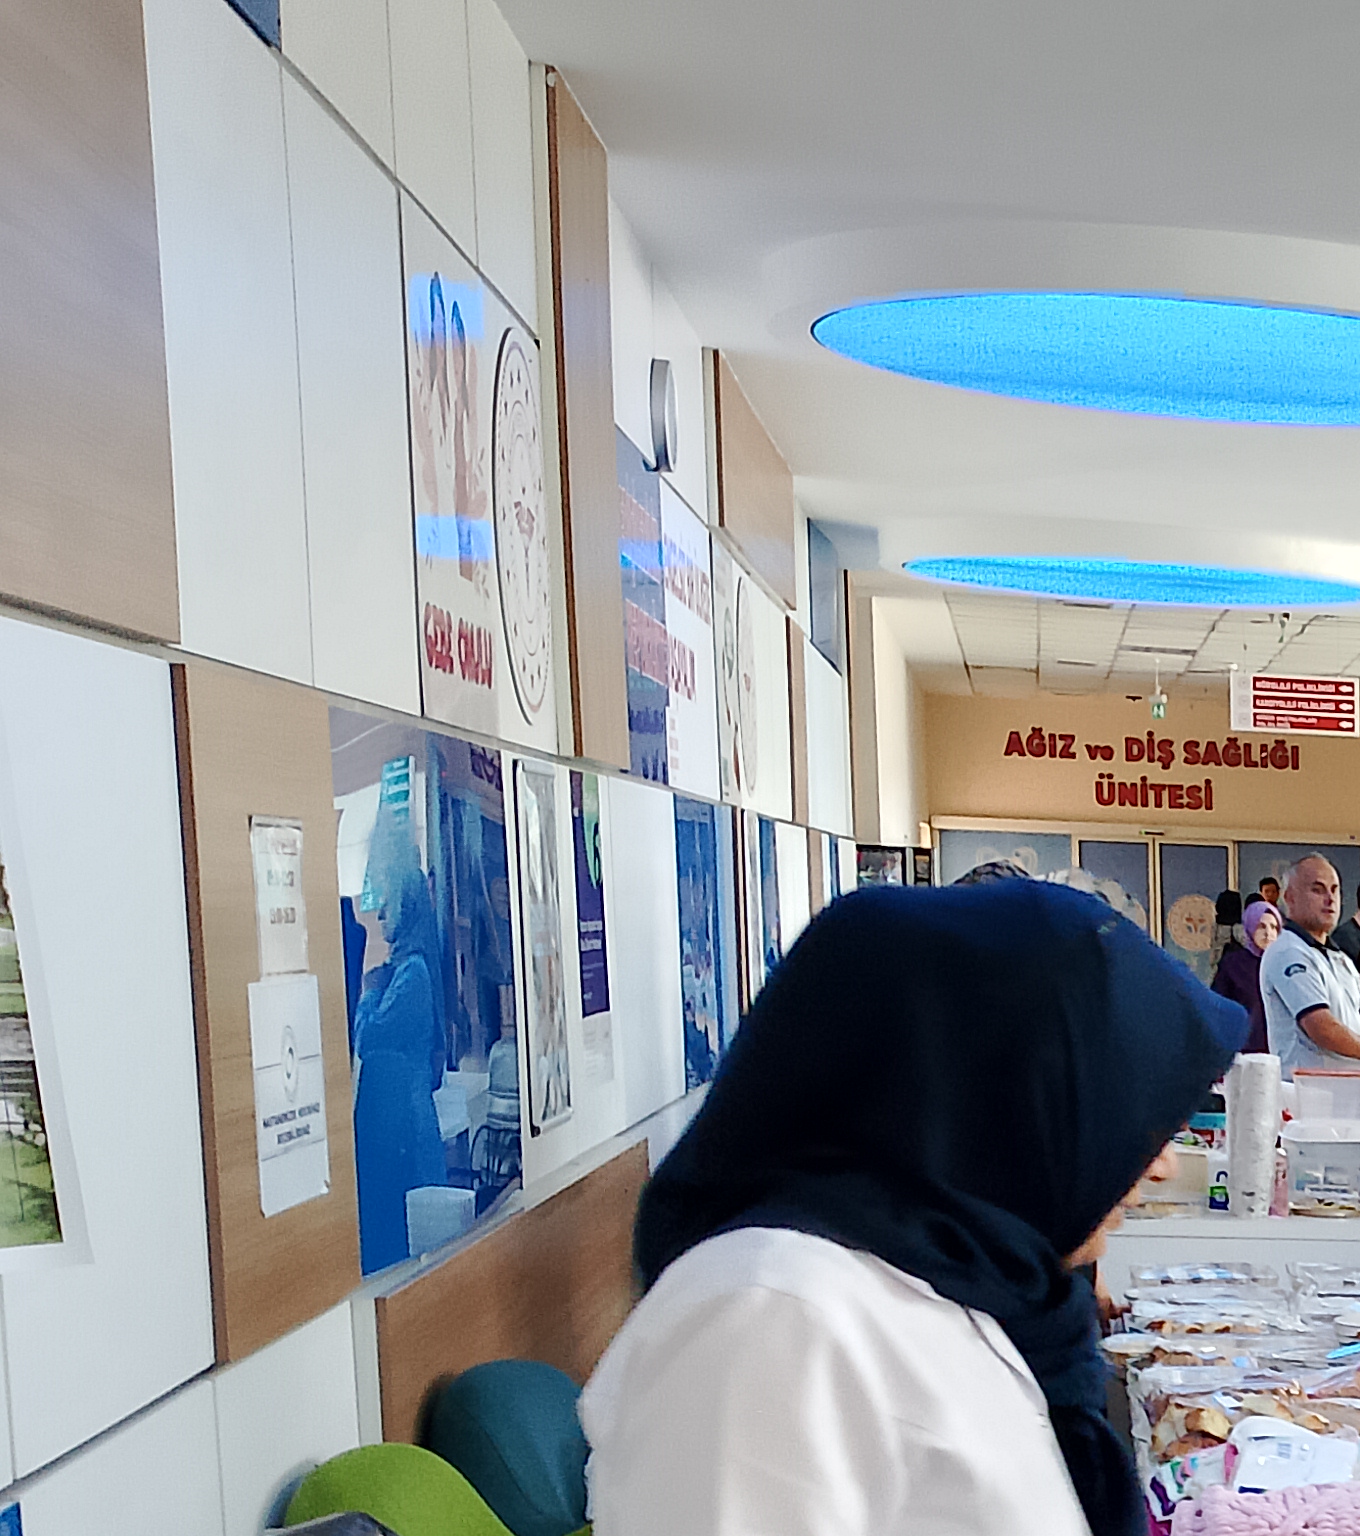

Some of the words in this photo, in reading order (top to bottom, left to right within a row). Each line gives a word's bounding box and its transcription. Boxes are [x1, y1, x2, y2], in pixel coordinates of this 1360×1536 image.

[1004, 727, 1077, 760] AĞIZ
[1084, 743, 1115, 761] ve
[1125, 730, 1175, 770] DİŞ
[1183, 737, 1300, 771] SAĞLIĞI
[1095, 773, 1213, 811] ÜNİTESİ
